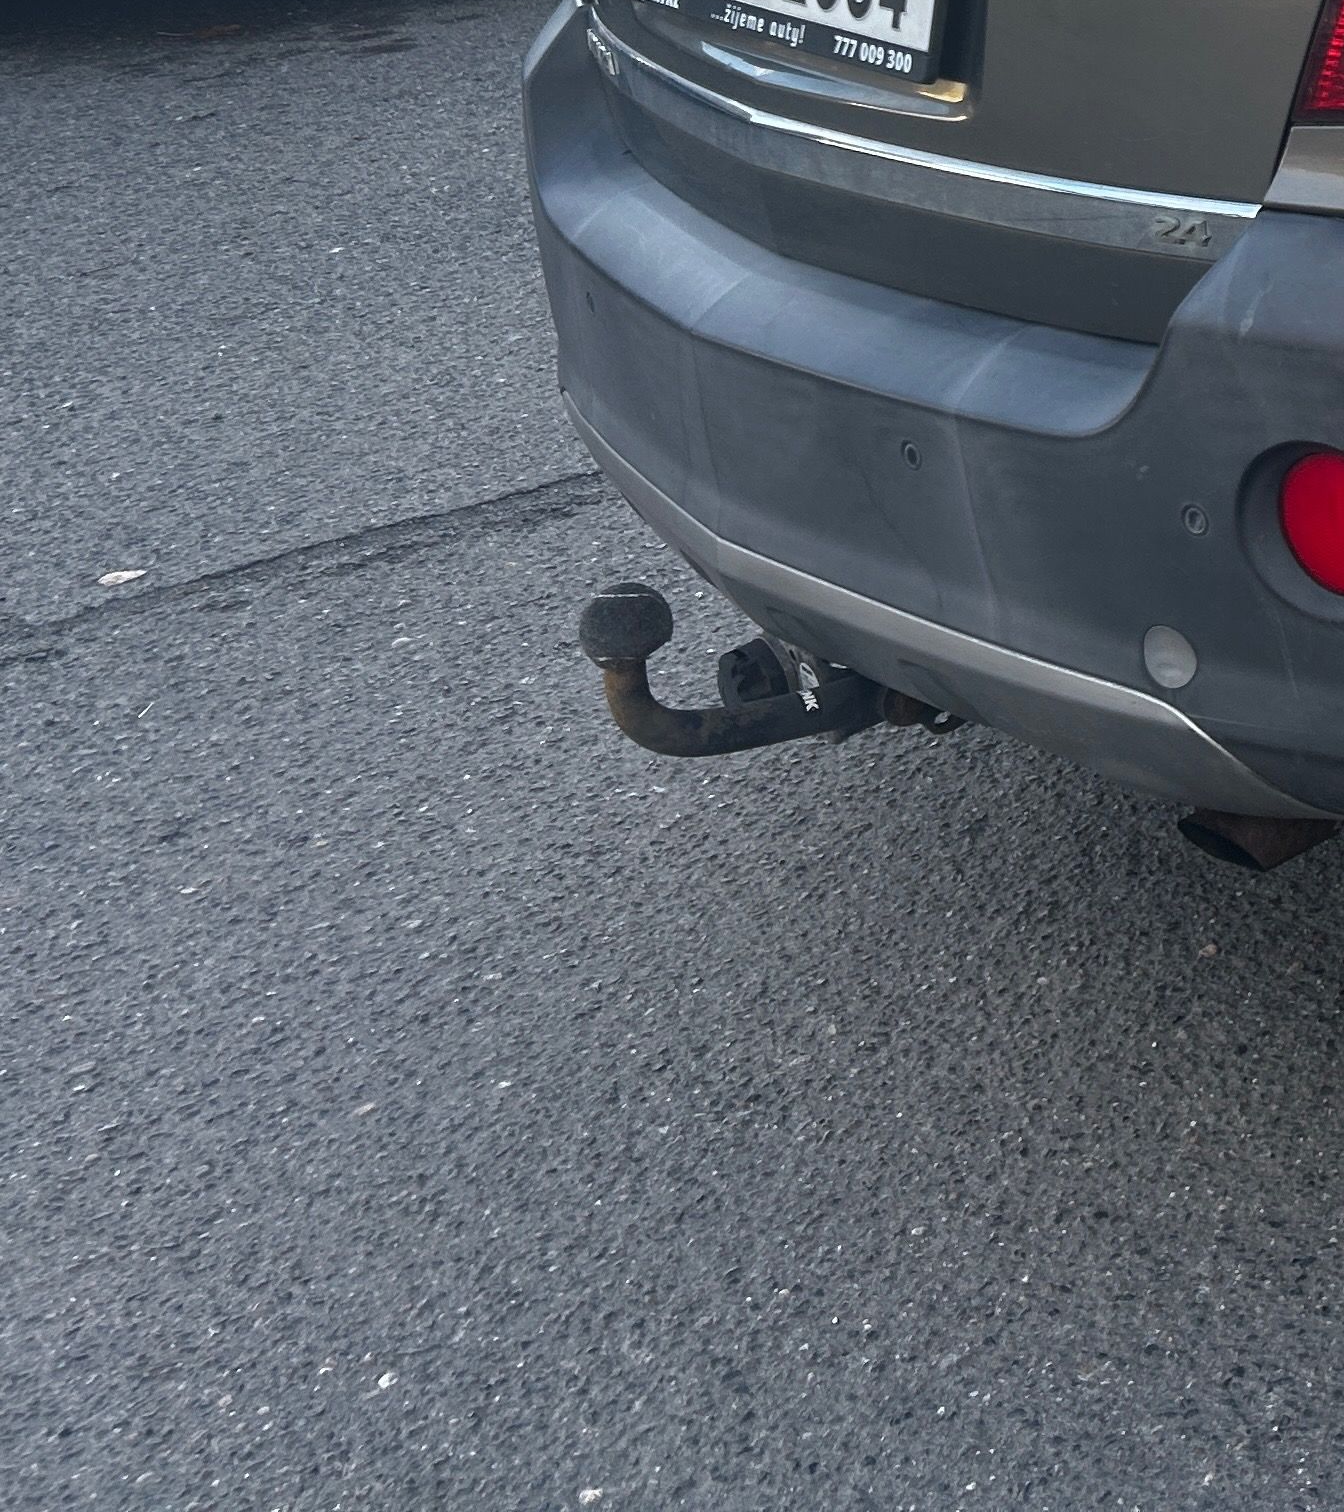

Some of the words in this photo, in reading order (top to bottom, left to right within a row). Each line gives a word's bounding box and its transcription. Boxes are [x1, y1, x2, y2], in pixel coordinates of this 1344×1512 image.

[769, 20, 806, 48] auty!
[832, 34, 858, 58] 777
[859, 42, 885, 66] 009
[886, 49, 912, 74] 300
